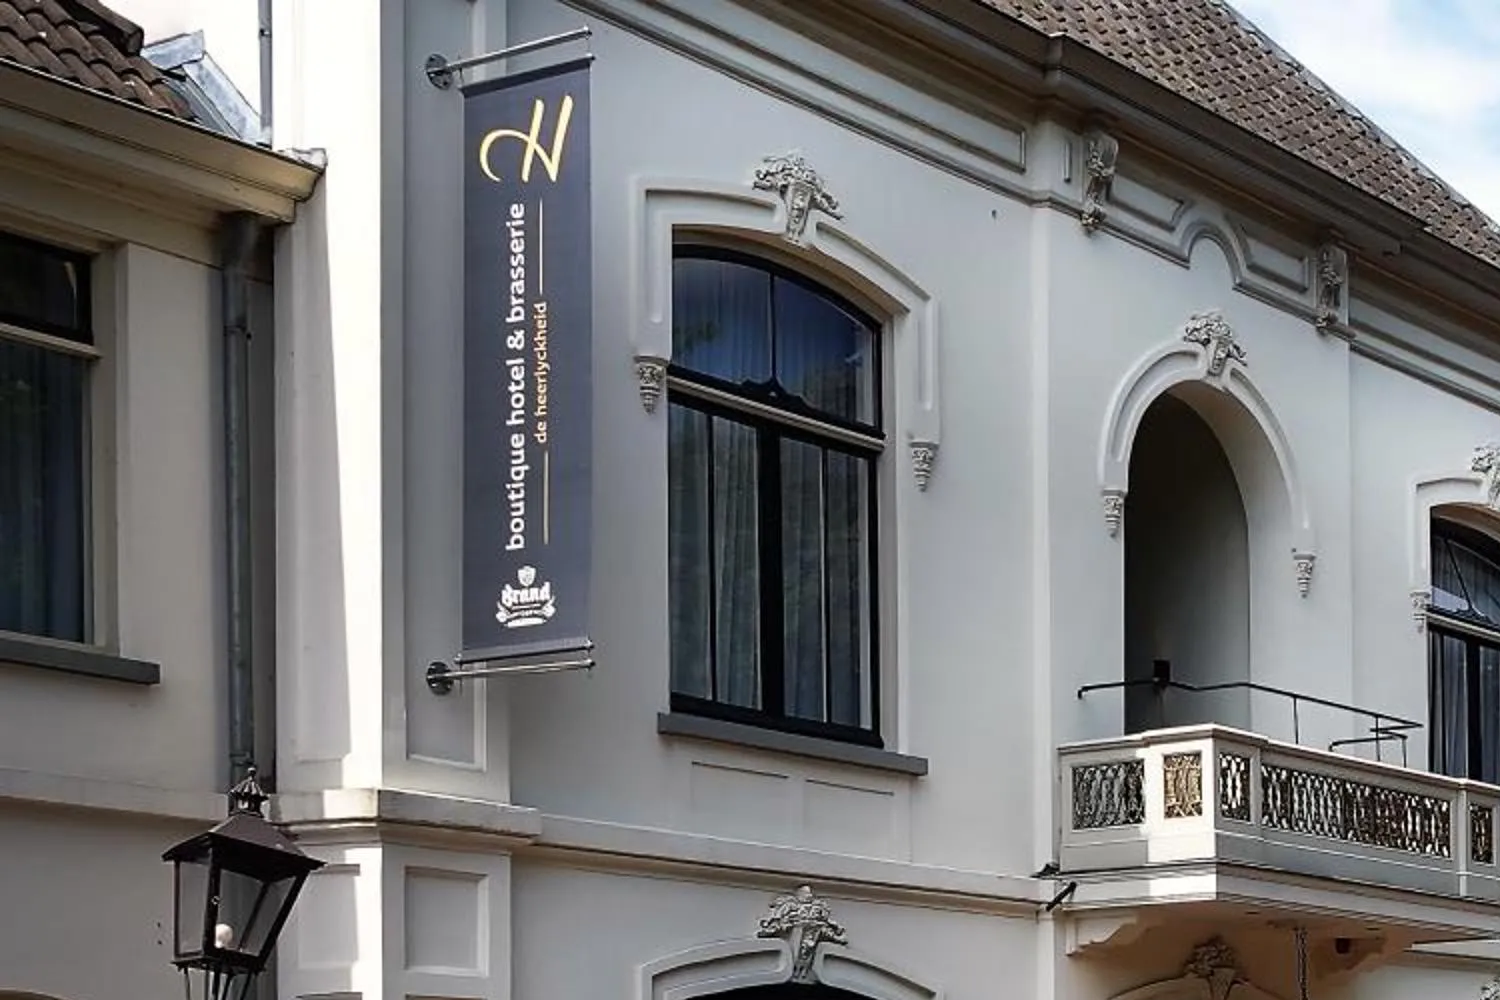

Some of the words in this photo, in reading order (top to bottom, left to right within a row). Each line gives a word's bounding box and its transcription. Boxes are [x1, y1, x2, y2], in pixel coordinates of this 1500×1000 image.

[505, 203, 526, 323] brasserie
[506, 329, 525, 351] &
[533, 301, 550, 417] heerlyckheid
[505, 358, 526, 426] hotel
[533, 421, 548, 444] de
[505, 433, 530, 551] boutique
